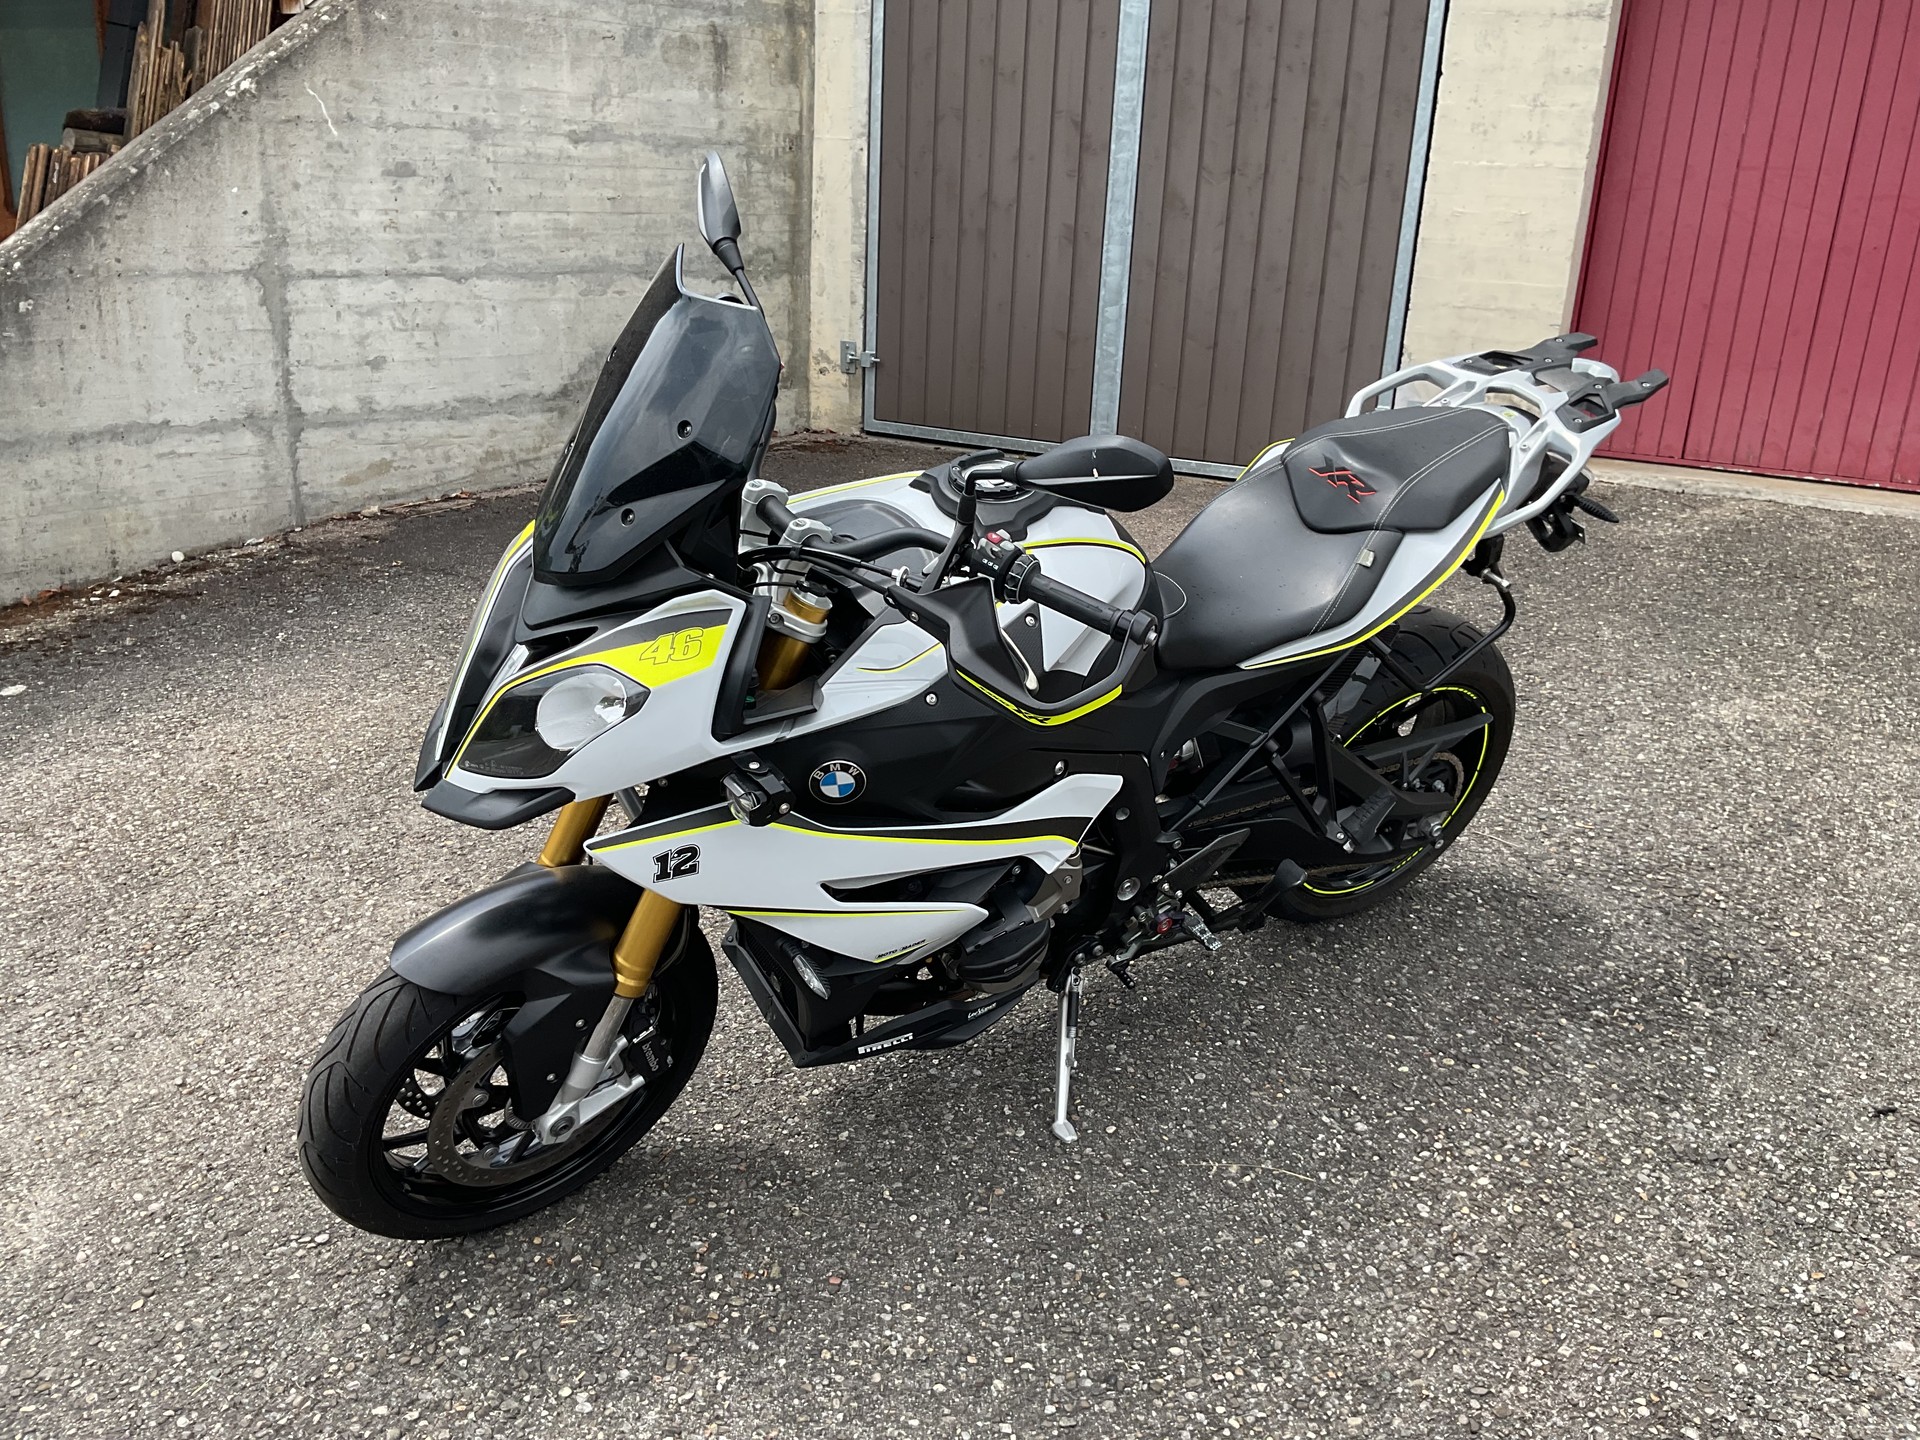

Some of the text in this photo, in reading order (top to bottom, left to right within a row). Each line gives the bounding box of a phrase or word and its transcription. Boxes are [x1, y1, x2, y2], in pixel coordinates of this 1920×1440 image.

[639, 626, 704, 665] 46
[813, 763, 860, 780] BMW
[652, 843, 701, 883] 12
[641, 1040, 659, 1072] brembo
[857, 1032, 914, 1054] PIRELLI
